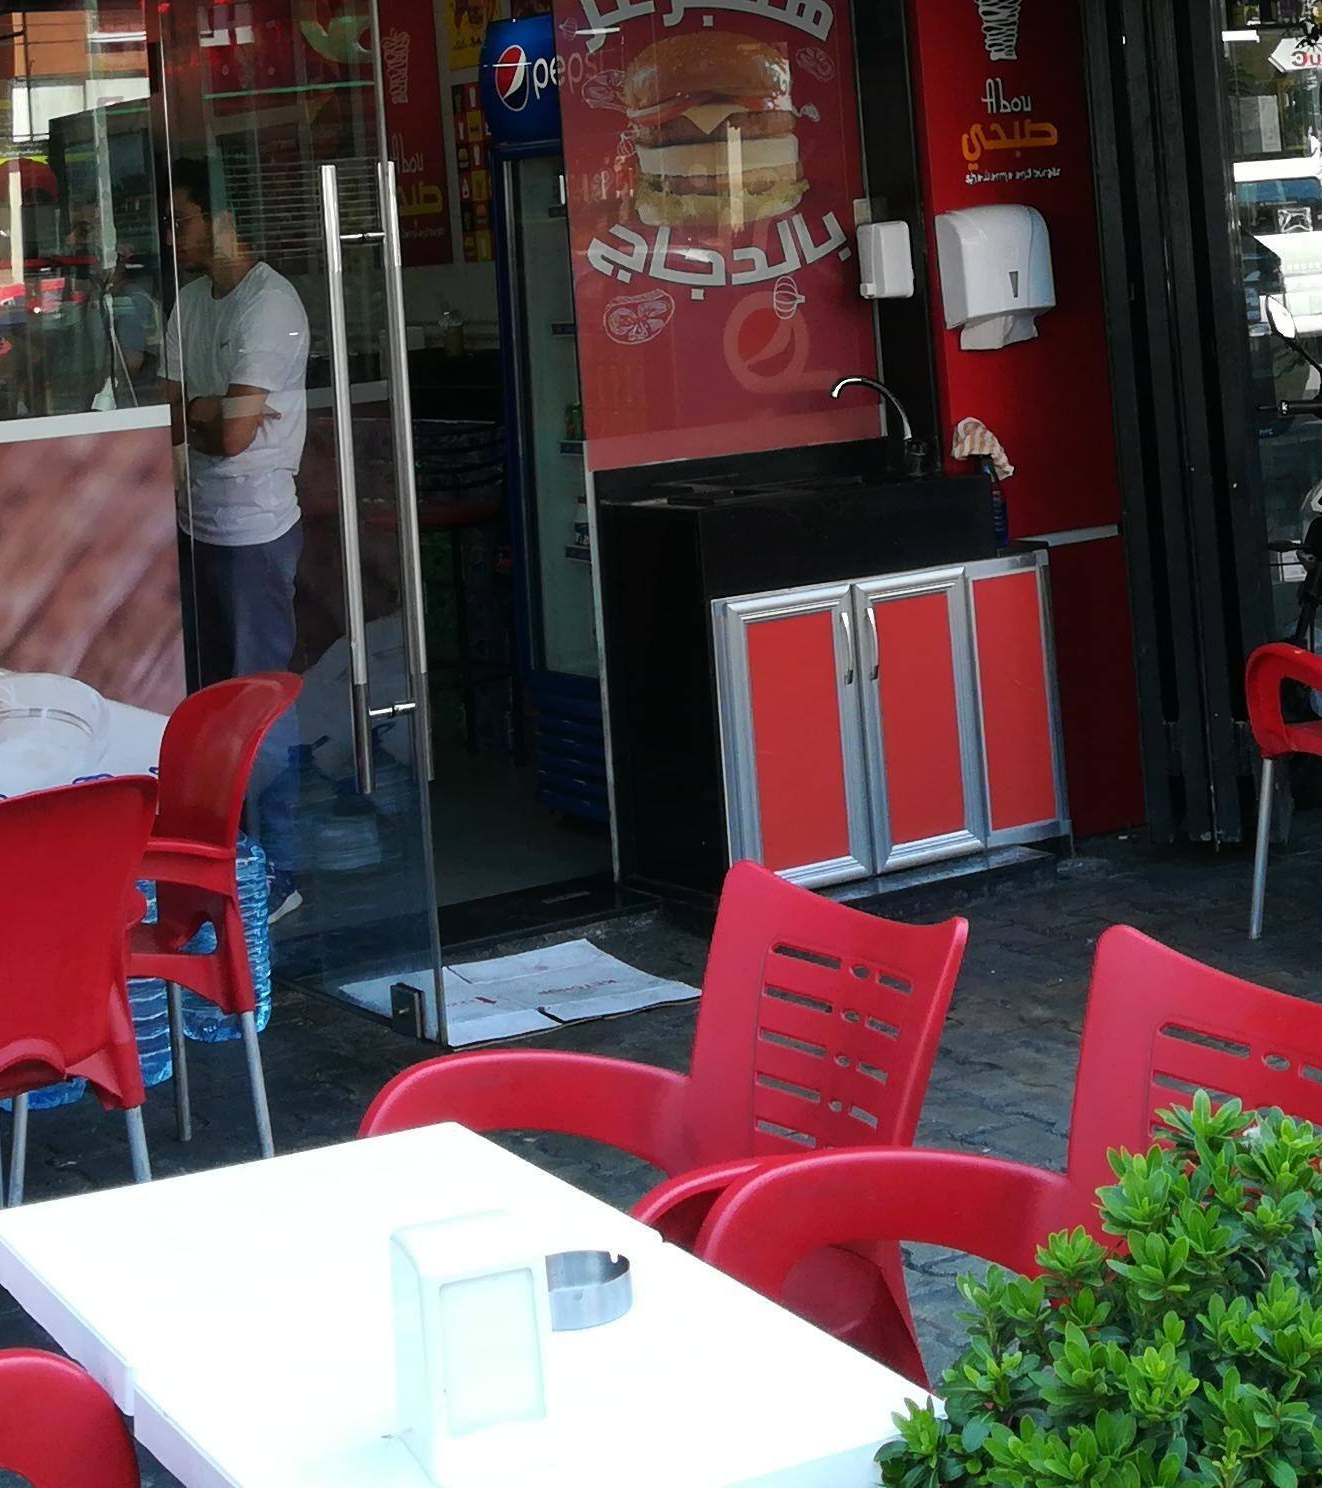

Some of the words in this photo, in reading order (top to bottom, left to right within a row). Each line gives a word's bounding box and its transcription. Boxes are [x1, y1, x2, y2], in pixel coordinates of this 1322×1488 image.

[980, 77, 1032, 114] Abou
[961, 119, 1059, 172] صبحي
[587, 212, 852, 300] بالدجاج
